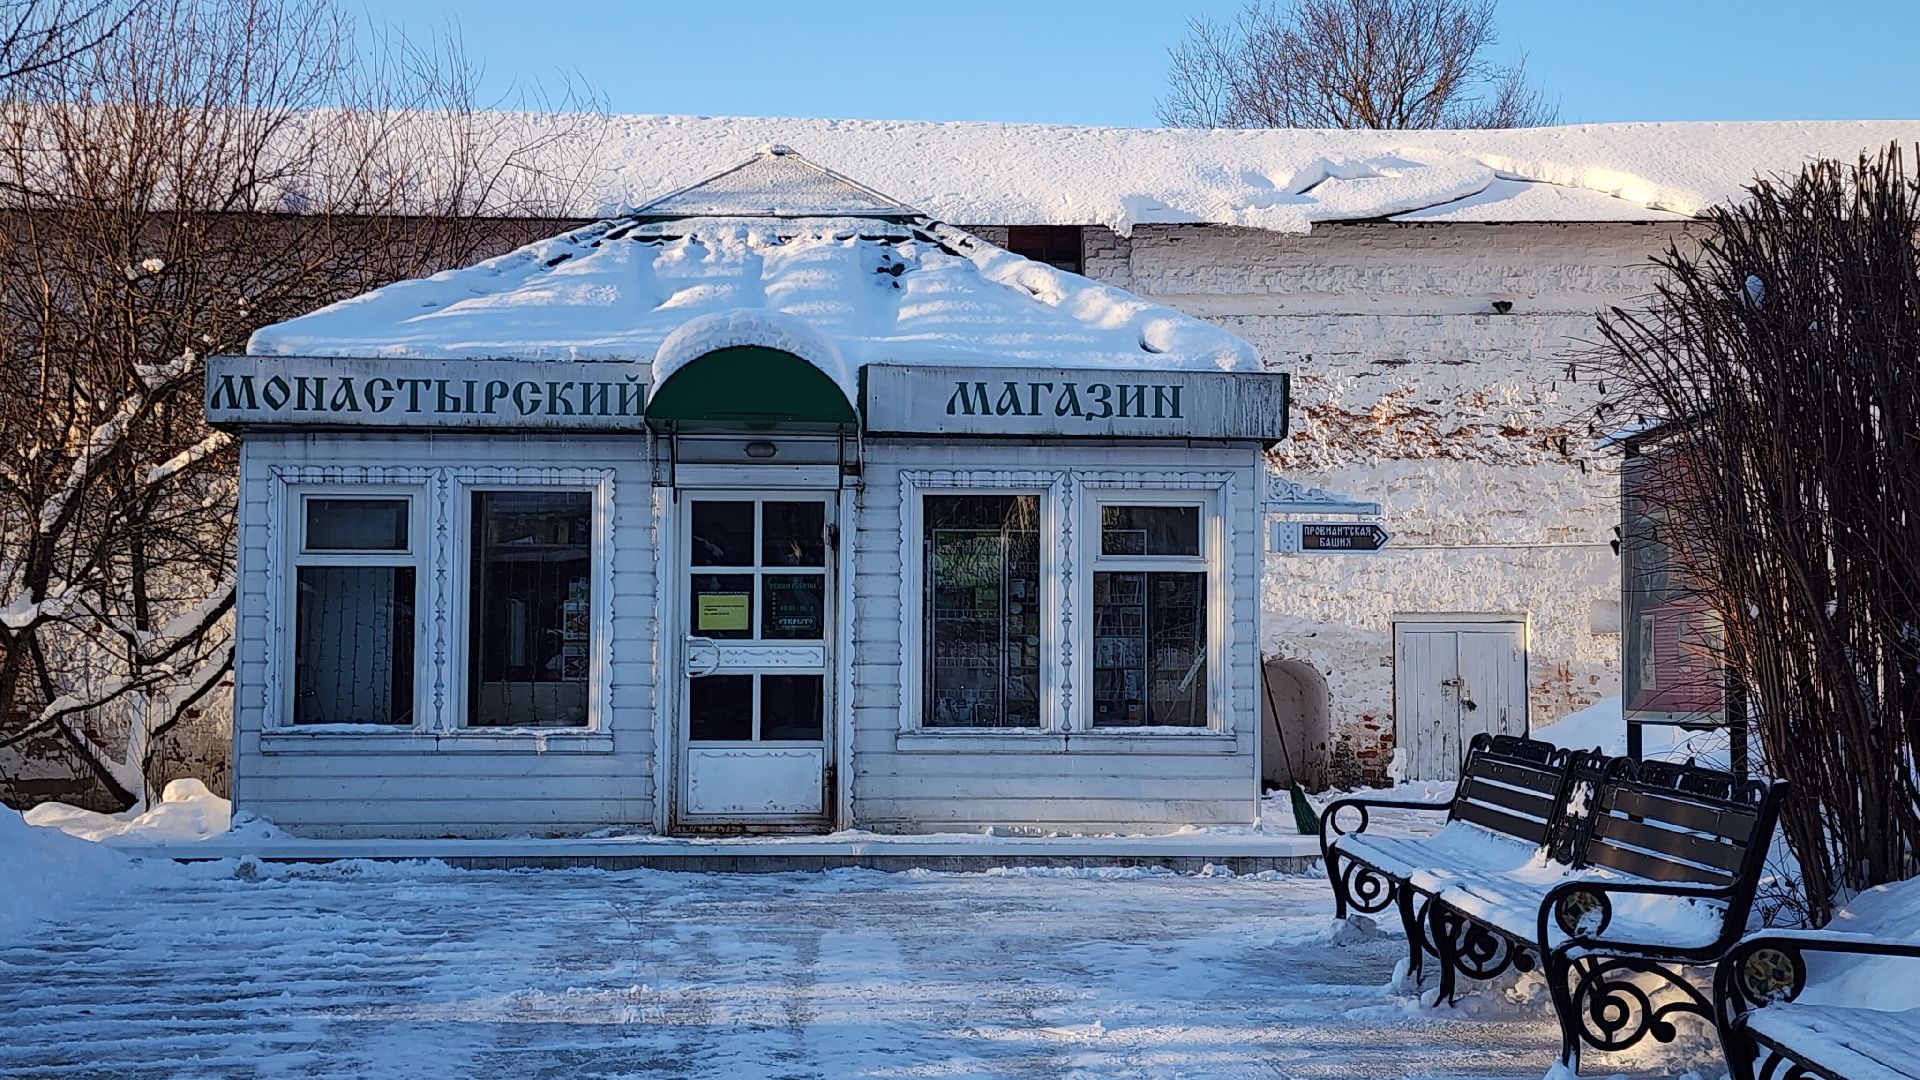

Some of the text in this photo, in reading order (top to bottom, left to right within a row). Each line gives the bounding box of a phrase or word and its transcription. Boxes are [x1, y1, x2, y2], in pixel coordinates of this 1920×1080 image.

[210, 373, 1184, 421] МОНАСТЫРСКИЙ МАГАЗИН
[1303, 526, 1371, 537] ПРОВИАНТСКАЯ
[1319, 537, 1352, 548] БАШНЯ
